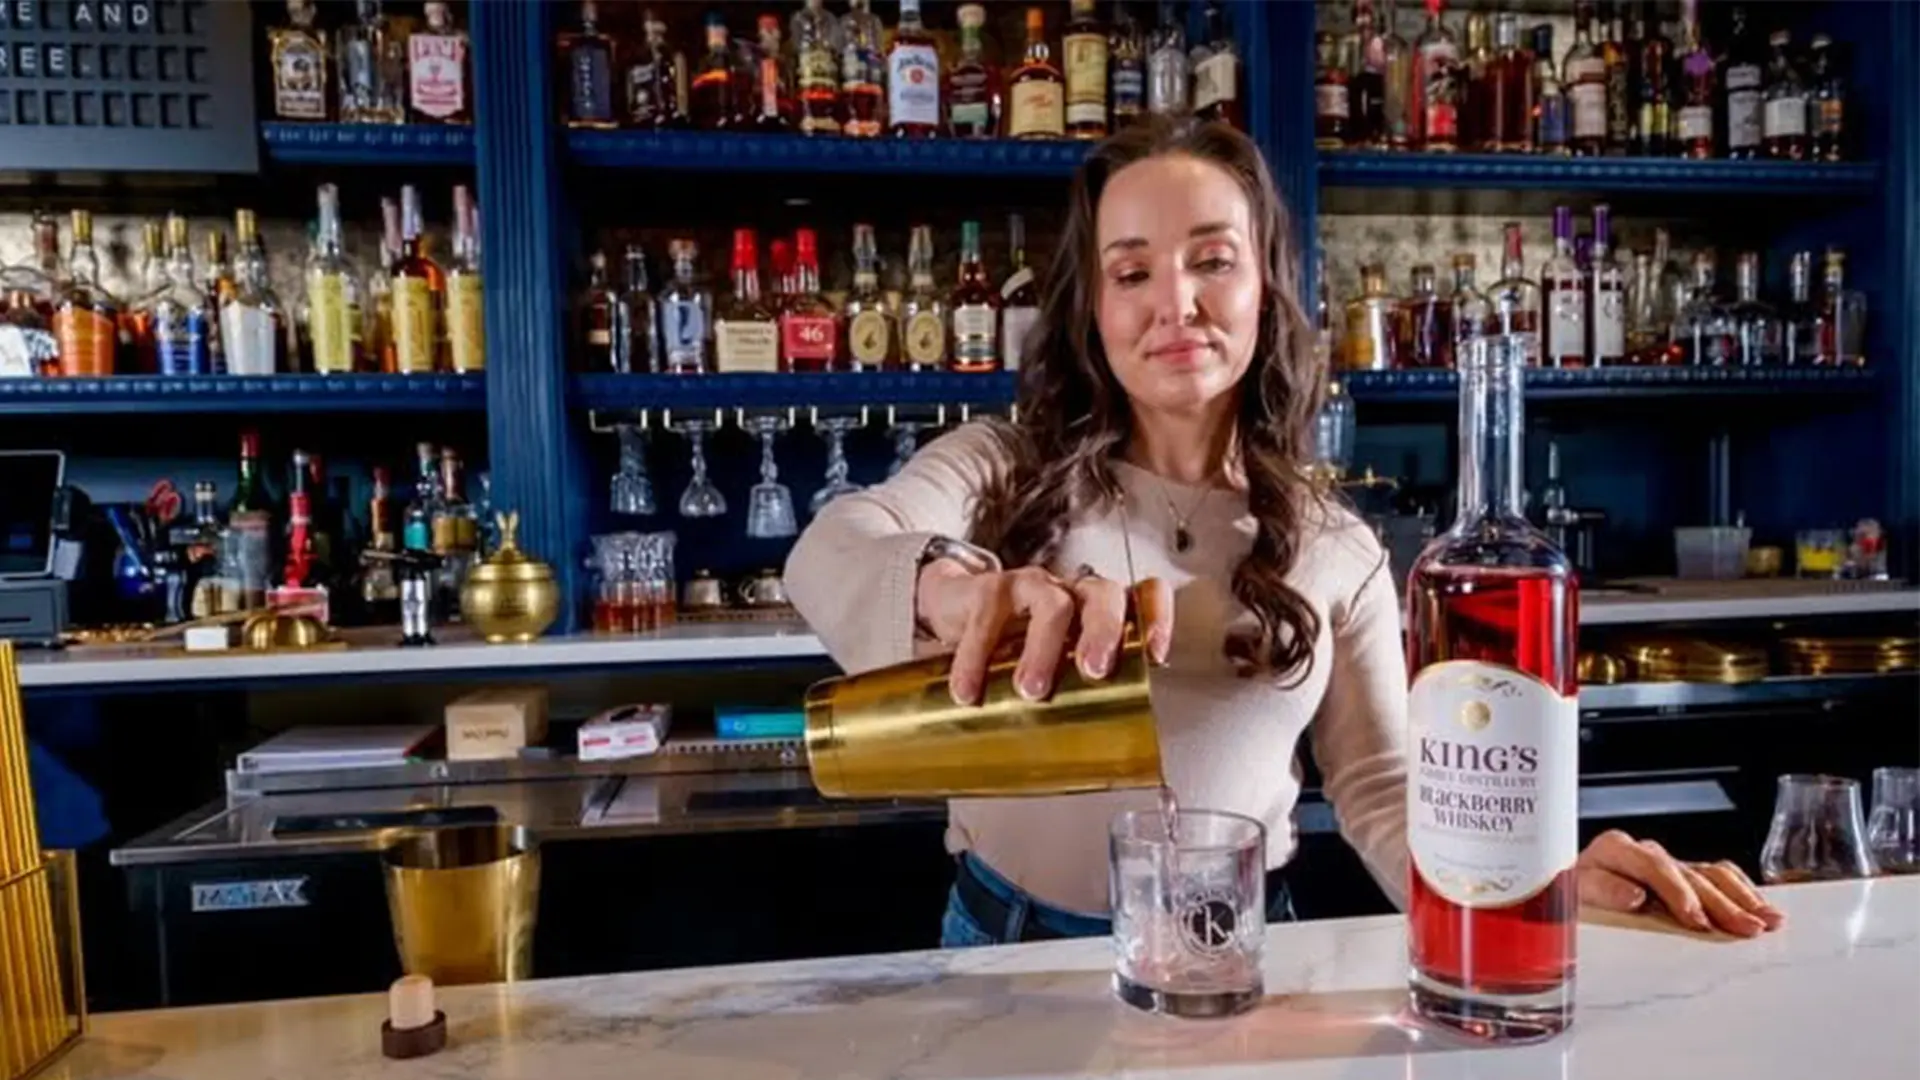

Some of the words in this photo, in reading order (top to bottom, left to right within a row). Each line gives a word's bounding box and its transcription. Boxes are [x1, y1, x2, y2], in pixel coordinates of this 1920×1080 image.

[75, 4, 149, 25] AND
[799, 326, 825, 342] 46
[1420, 737, 1538, 774] KING'S
[1420, 784, 1538, 815] BLACKBERRY
[1434, 807, 1516, 832] WHISKEY
